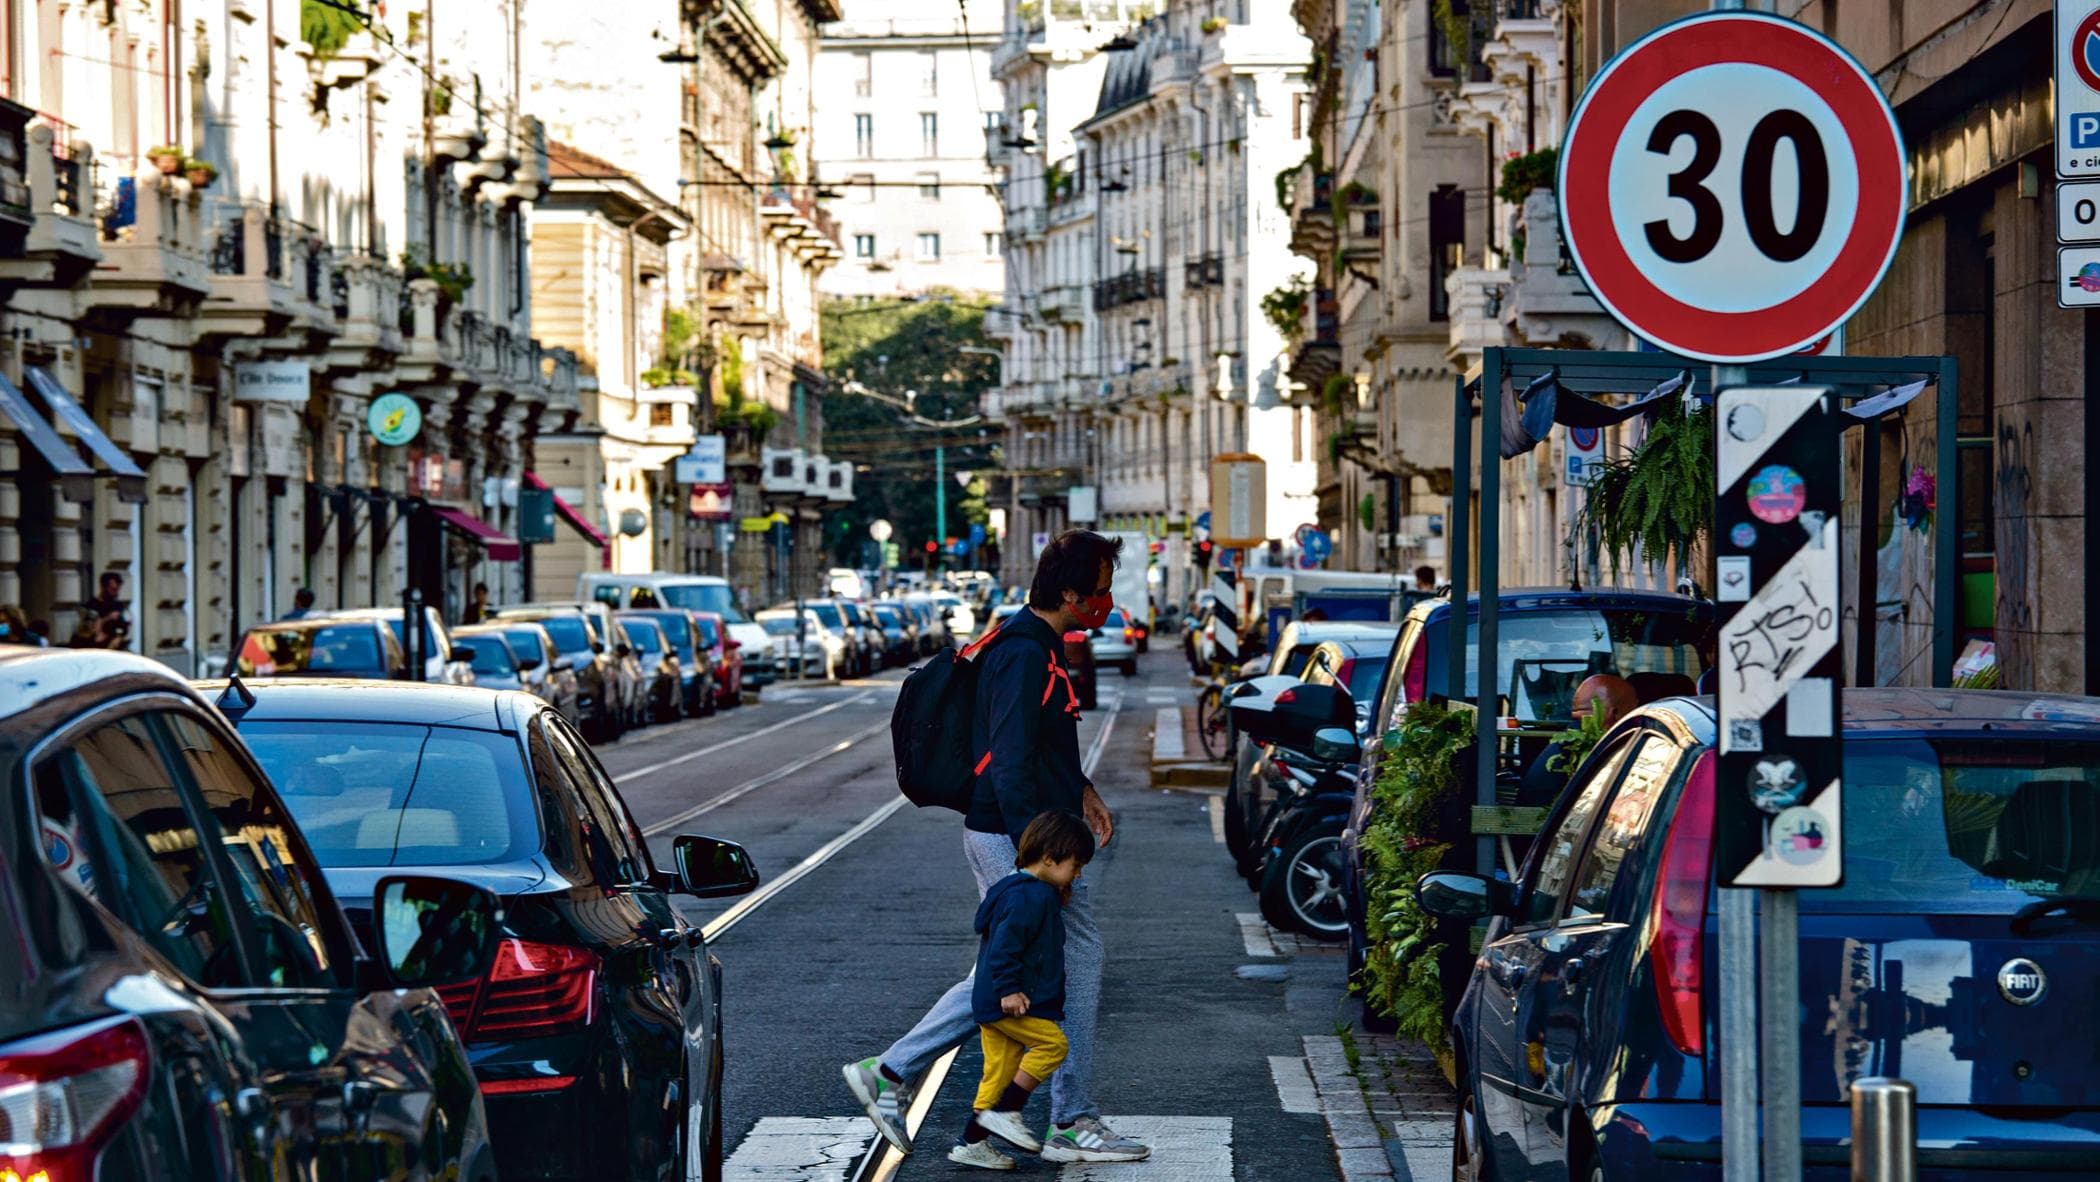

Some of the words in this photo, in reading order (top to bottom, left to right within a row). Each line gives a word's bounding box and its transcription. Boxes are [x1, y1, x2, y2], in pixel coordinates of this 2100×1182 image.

[2078, 117, 2099, 144] P
[1643, 108, 1829, 263] 30
[2006, 973, 2038, 989] FIAT
